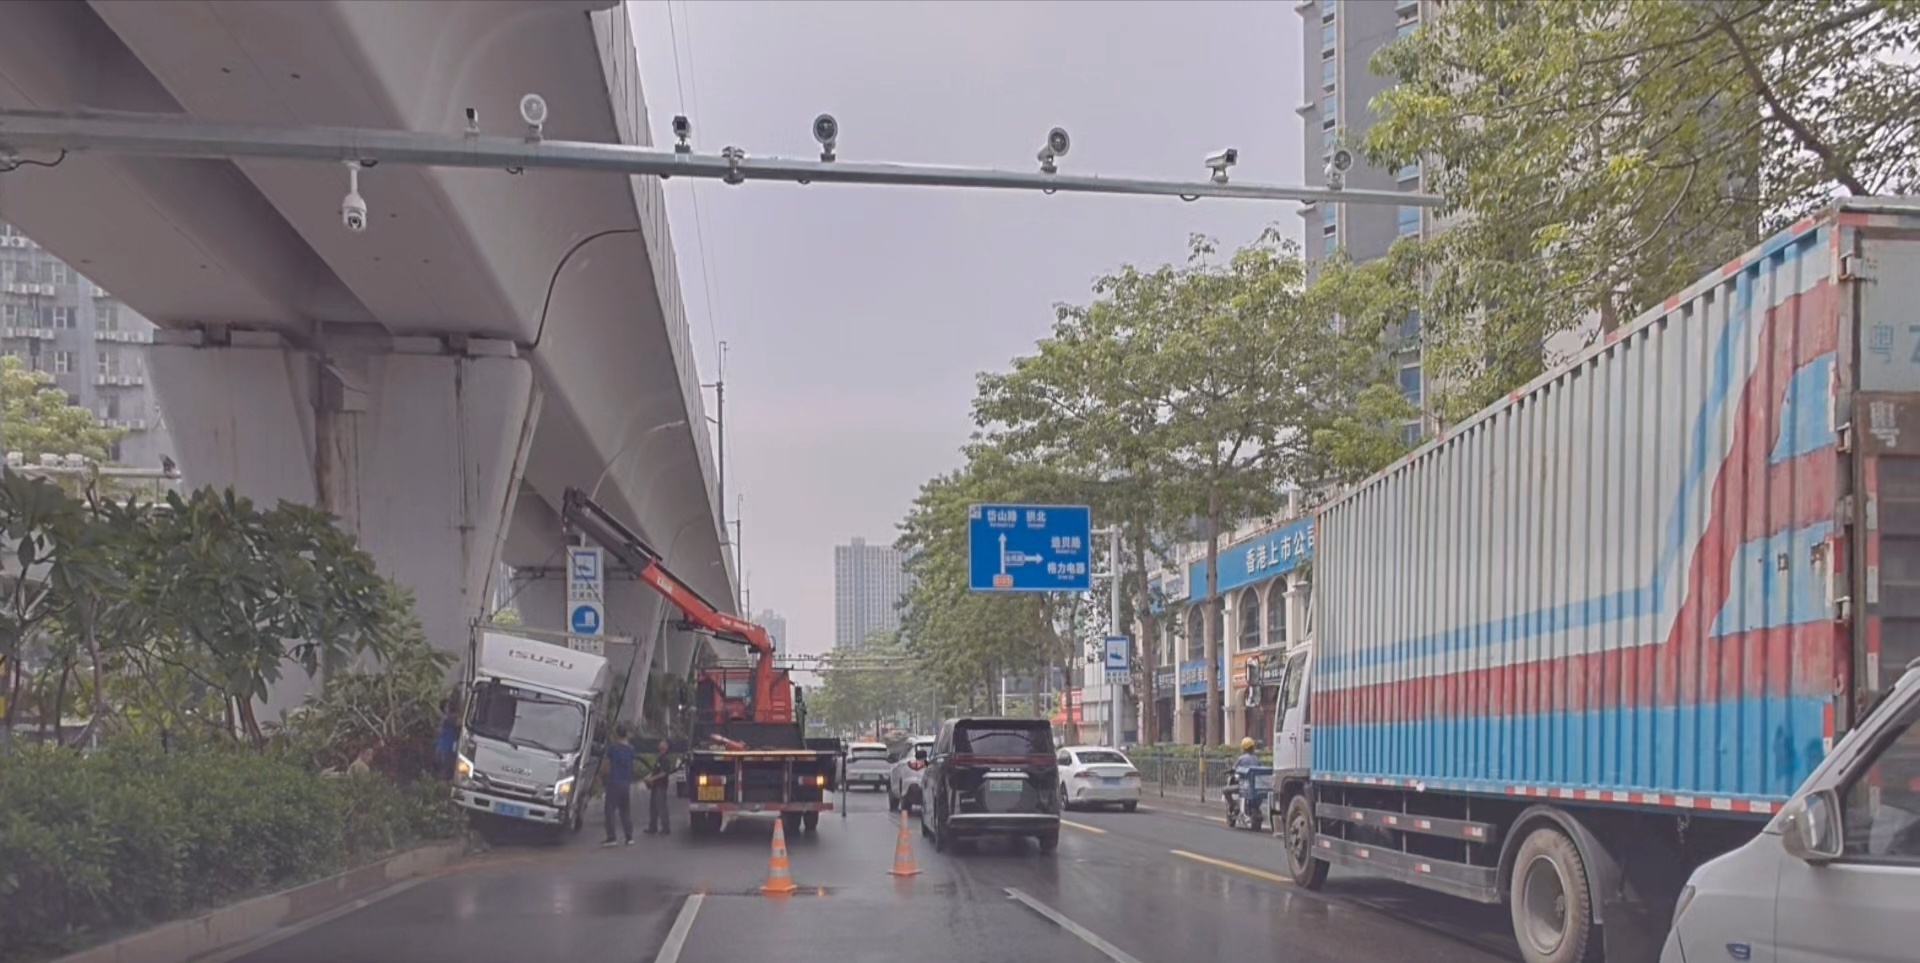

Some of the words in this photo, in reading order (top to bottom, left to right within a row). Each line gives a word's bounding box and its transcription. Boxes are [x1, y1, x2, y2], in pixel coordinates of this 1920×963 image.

[1869, 401, 1900, 447] 粤
[1026, 510, 1047, 523] 拱北
[1246, 525, 1314, 574] 香港上市公司
[1047, 562, 1086, 574] 格力电器
[508, 649, 574, 670] ISUZU
